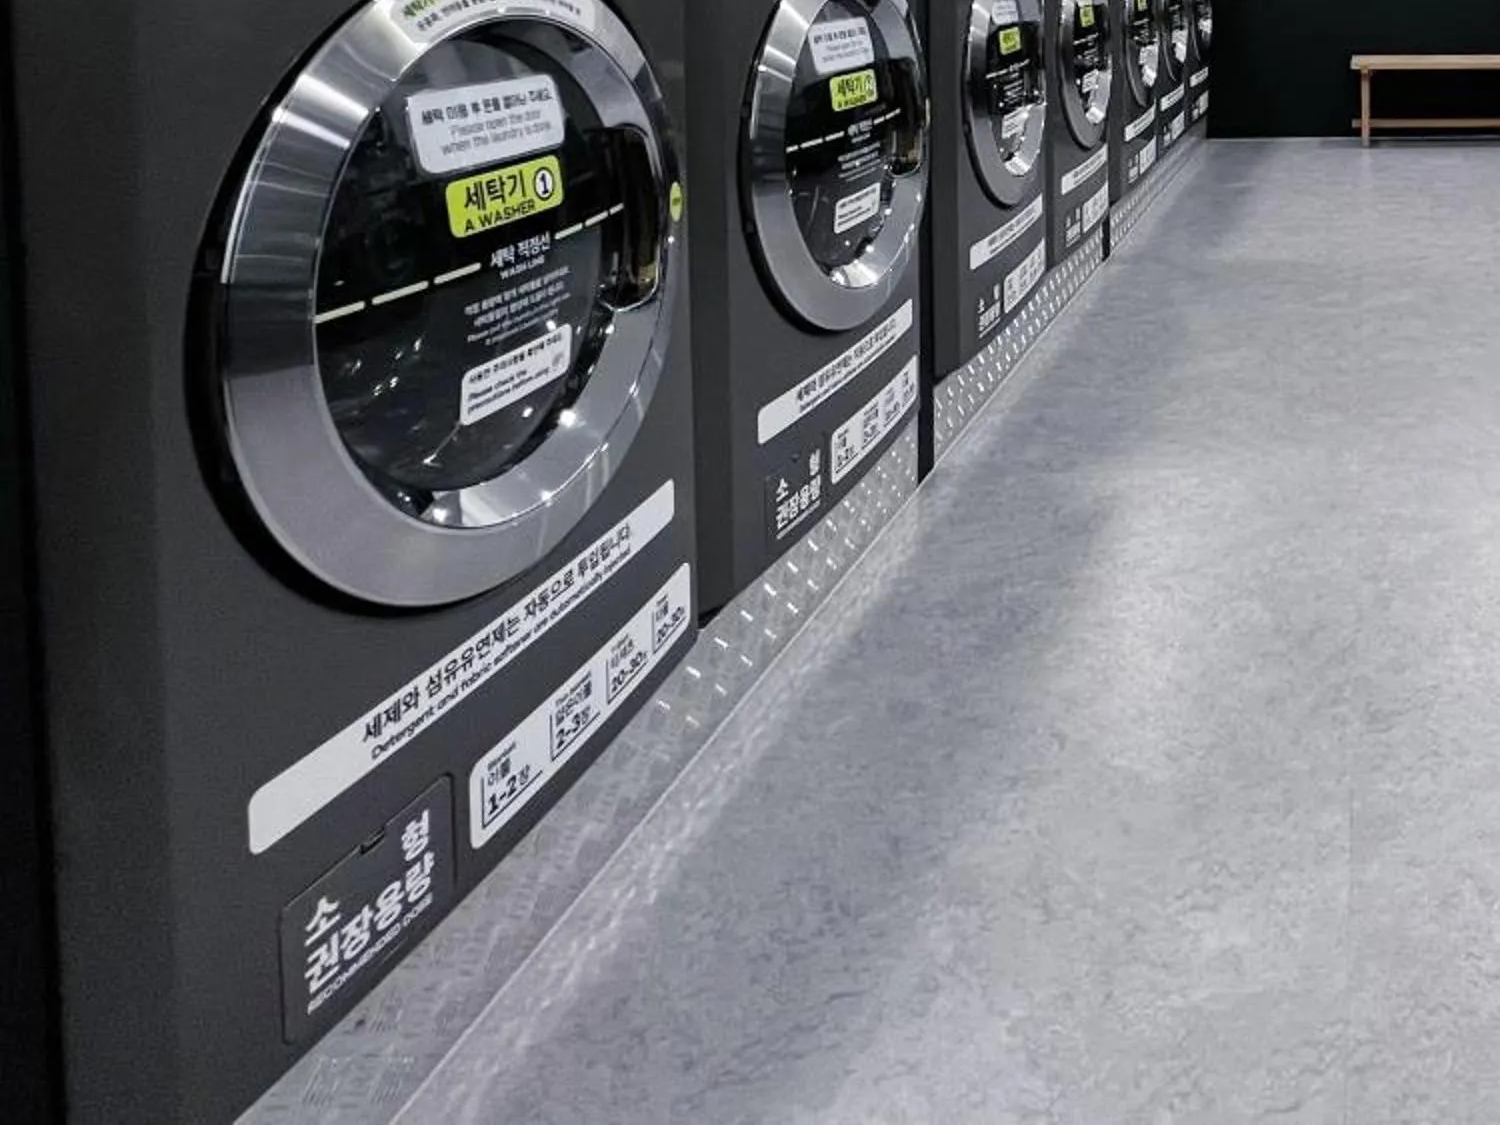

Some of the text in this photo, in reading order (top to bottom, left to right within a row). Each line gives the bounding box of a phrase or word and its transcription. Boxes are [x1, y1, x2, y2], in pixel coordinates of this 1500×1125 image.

[464, 169, 527, 211] 세탁기
[465, 199, 536, 233] A WASHER
[362, 685, 420, 742] 세제와
[426, 616, 520, 698] 섬유유연제는
[524, 569, 575, 621] 자동으로
[371, 705, 435, 760] Detergent
[437, 685, 459, 710] and
[460, 662, 492, 692] fabric
[304, 895, 341, 947] 소
[304, 851, 436, 995] 권장용량
